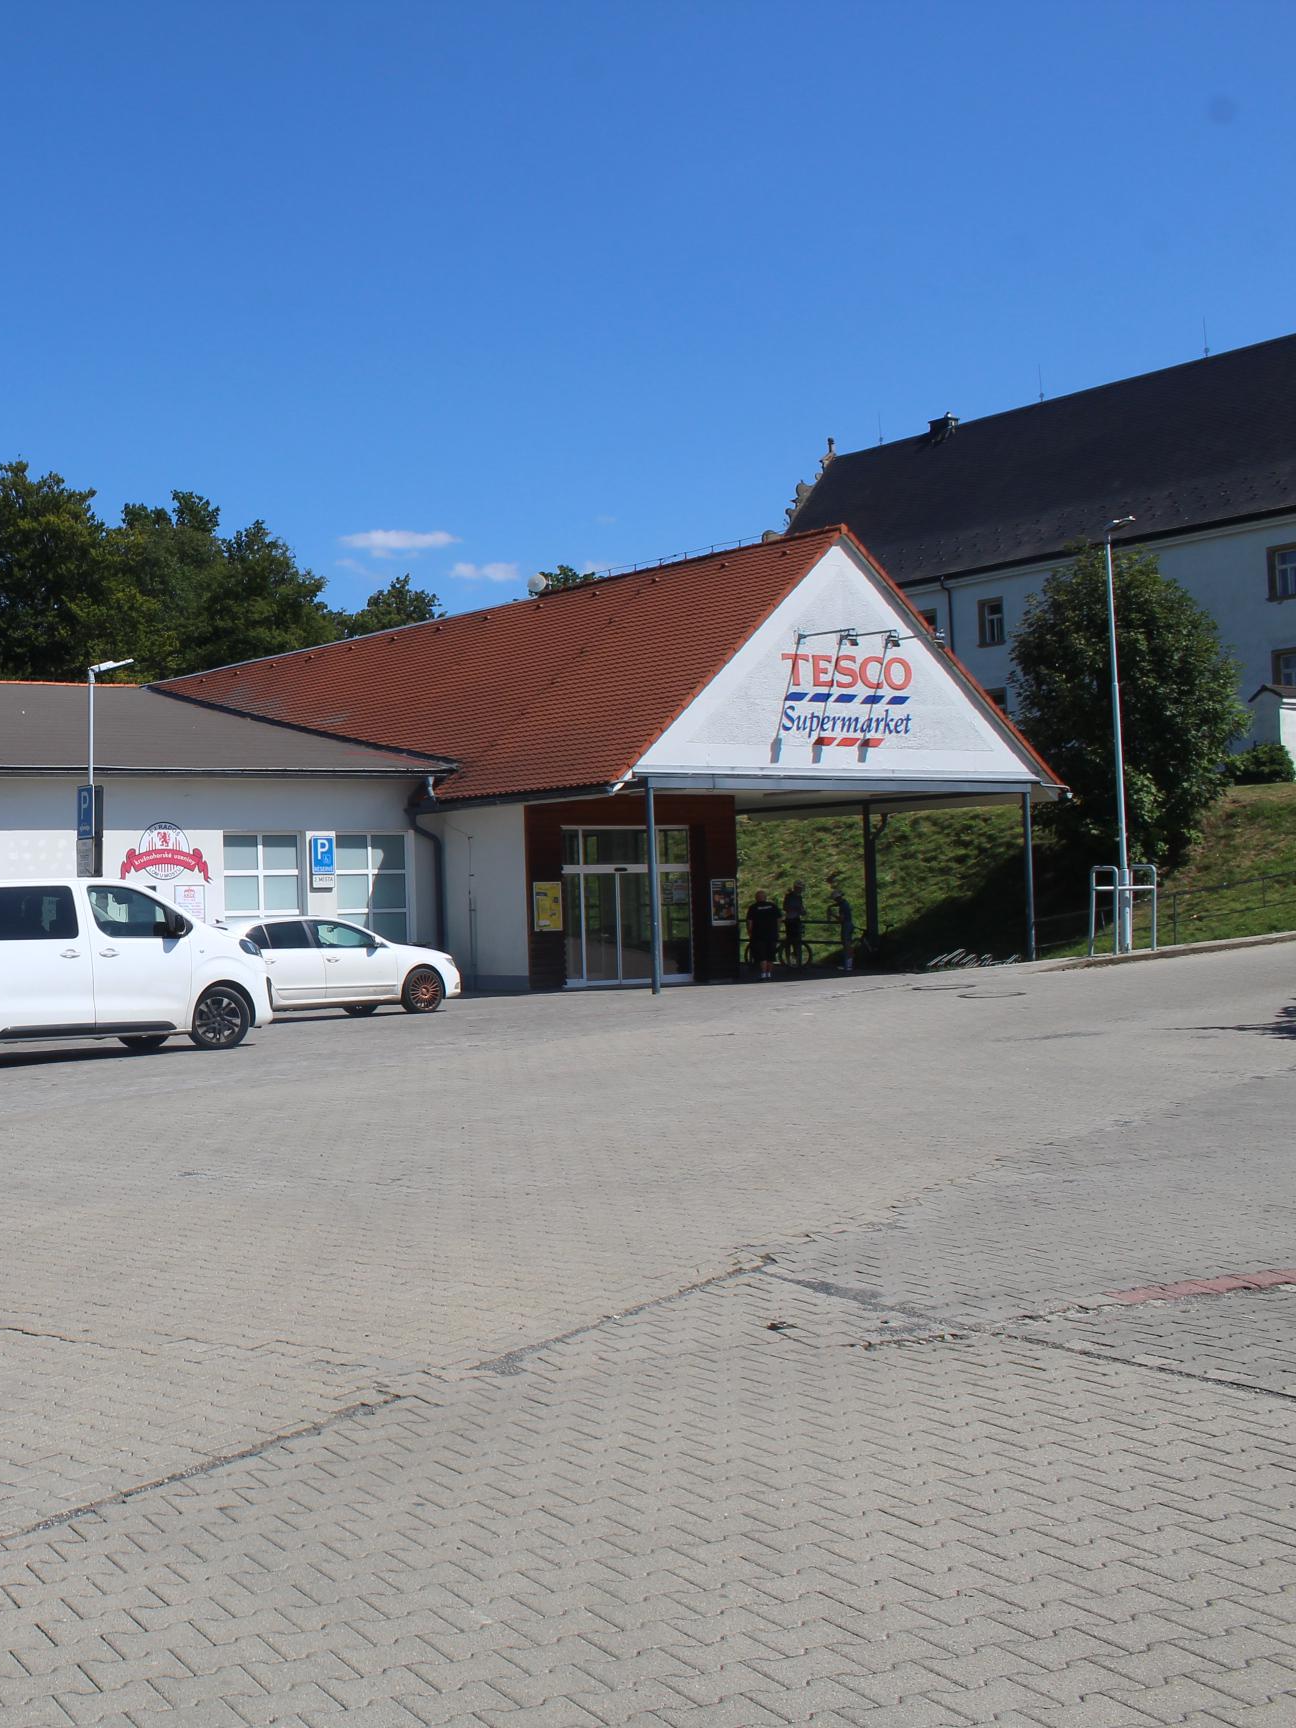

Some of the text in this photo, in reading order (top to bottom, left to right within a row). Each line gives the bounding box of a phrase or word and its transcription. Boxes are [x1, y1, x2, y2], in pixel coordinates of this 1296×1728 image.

[781, 653, 913, 691] TESCO
[781, 705, 912, 738] Supermarket
[81, 791, 89, 819] P
[317, 839, 329, 860] P
